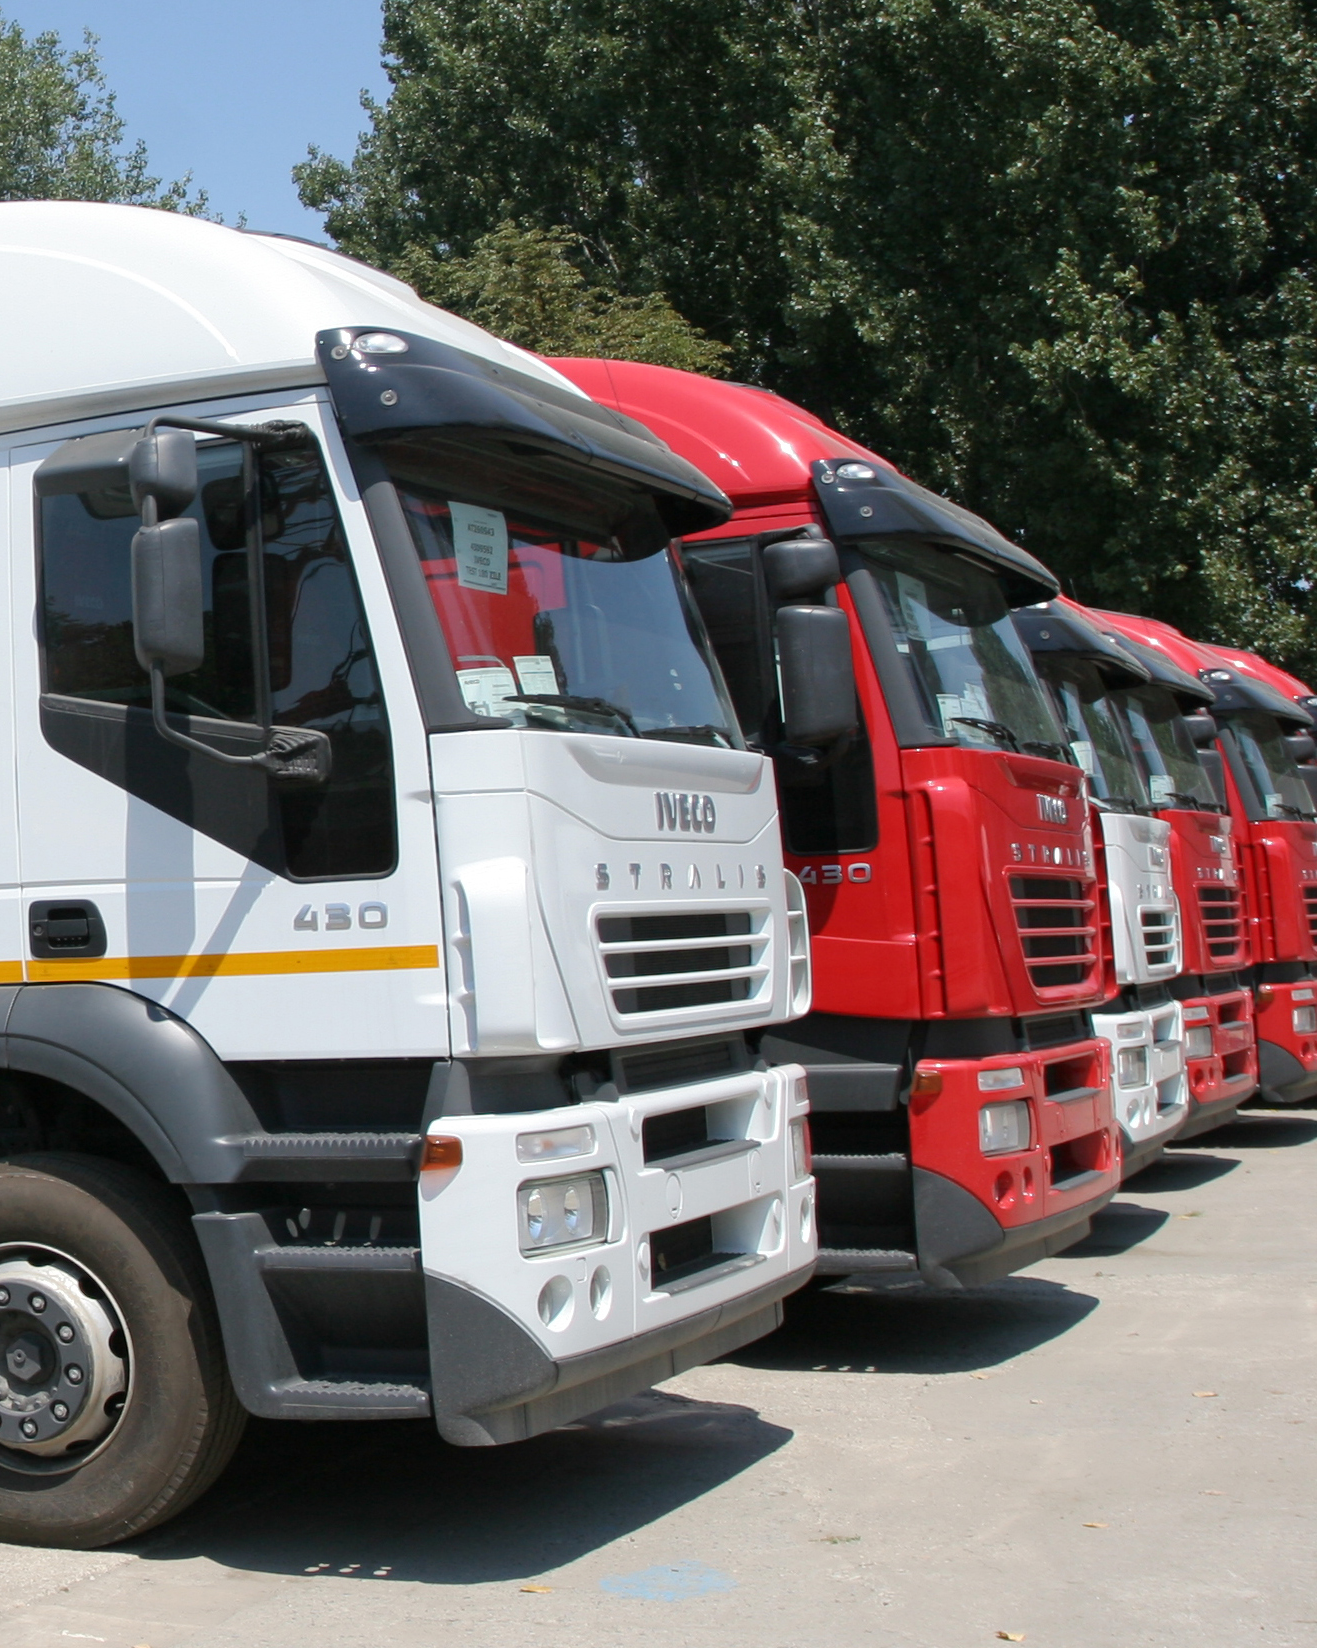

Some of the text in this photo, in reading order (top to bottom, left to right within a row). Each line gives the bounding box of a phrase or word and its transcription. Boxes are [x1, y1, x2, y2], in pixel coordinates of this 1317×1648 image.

[654, 791, 716, 834] IVECO
[594, 862, 767, 891] STRALIS
[798, 862, 872, 885] 430
[293, 901, 388, 932] 430
